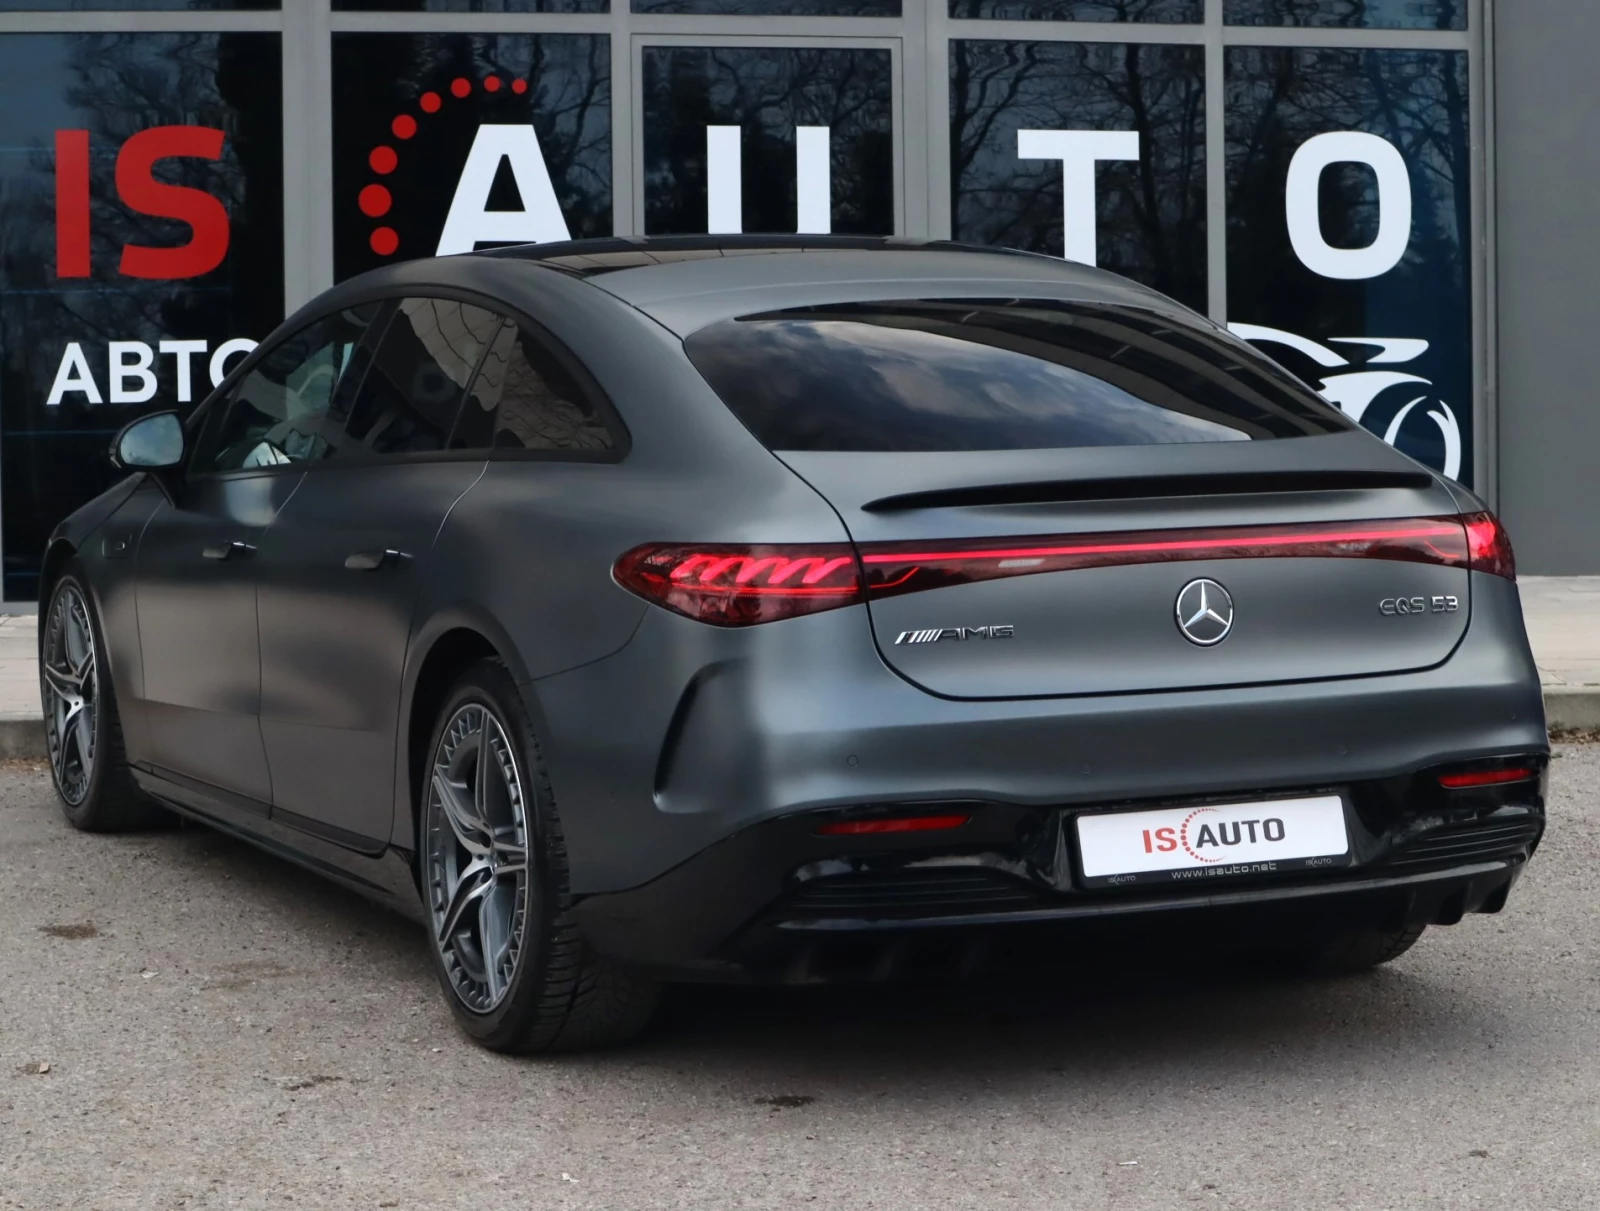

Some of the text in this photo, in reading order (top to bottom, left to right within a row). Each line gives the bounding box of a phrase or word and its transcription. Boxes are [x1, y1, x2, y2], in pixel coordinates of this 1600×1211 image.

[54, 125, 230, 280] IS
[1380, 595, 1459, 615] EQS 53
[934, 625, 1014, 642] AMG
[1142, 817, 1286, 854] IS AUTO
[1171, 861, 1277, 880] www.isauto.net
